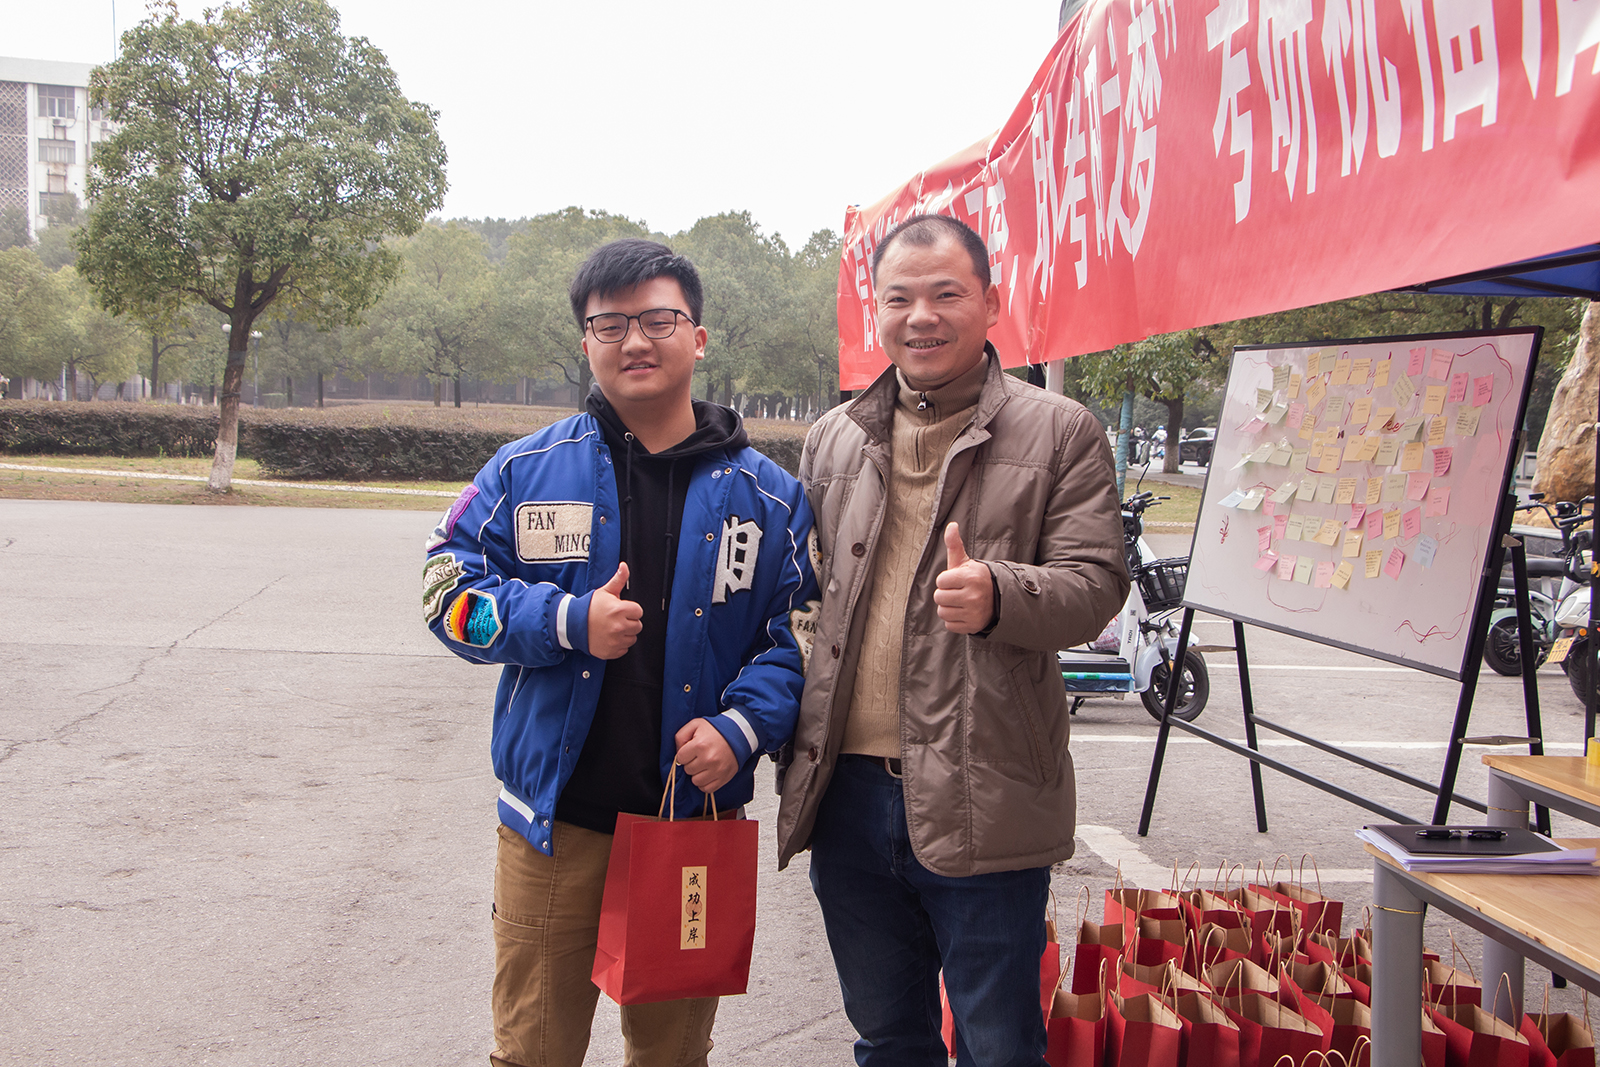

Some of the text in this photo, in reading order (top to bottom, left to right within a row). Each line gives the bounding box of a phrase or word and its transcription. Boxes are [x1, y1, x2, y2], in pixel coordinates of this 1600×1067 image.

[527, 512, 556, 530] FAN
[555, 533, 591, 554] MING
[687, 873, 702, 944] 成功上岸
